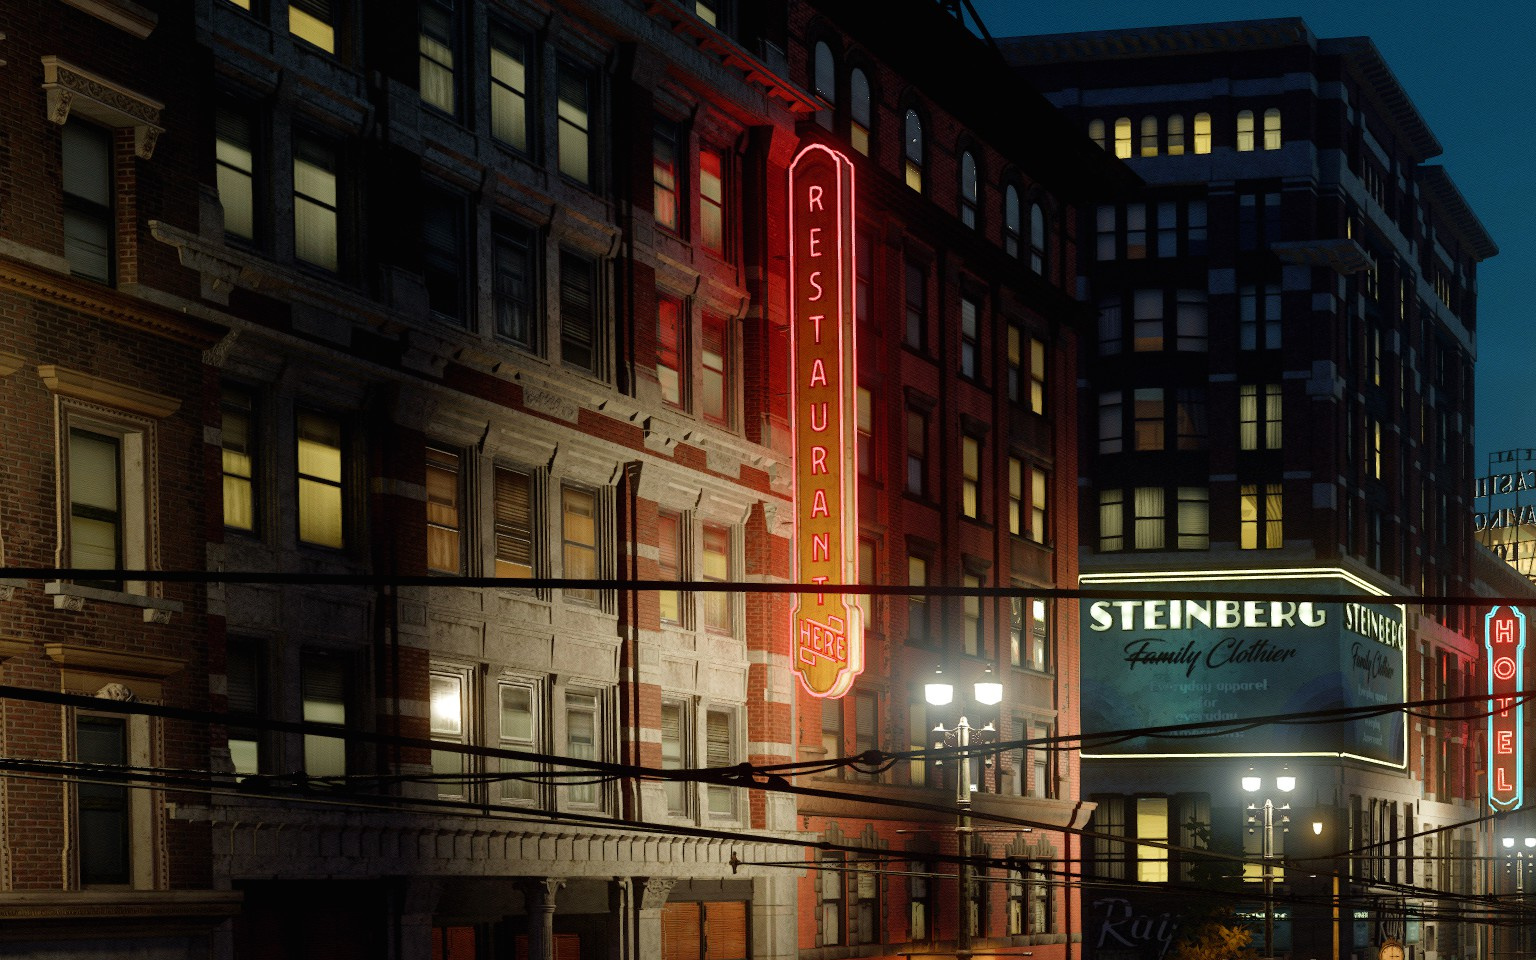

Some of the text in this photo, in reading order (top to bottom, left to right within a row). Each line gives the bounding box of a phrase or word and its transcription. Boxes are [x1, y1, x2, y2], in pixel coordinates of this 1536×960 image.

[808, 184, 829, 606] RESTAURANT
[1089, 600, 1327, 632] STEINBERG
[800, 618, 846, 662] HERE
[1123, 637, 1297, 678] Family Clothier
[1495, 619, 1514, 791] HOTEL
